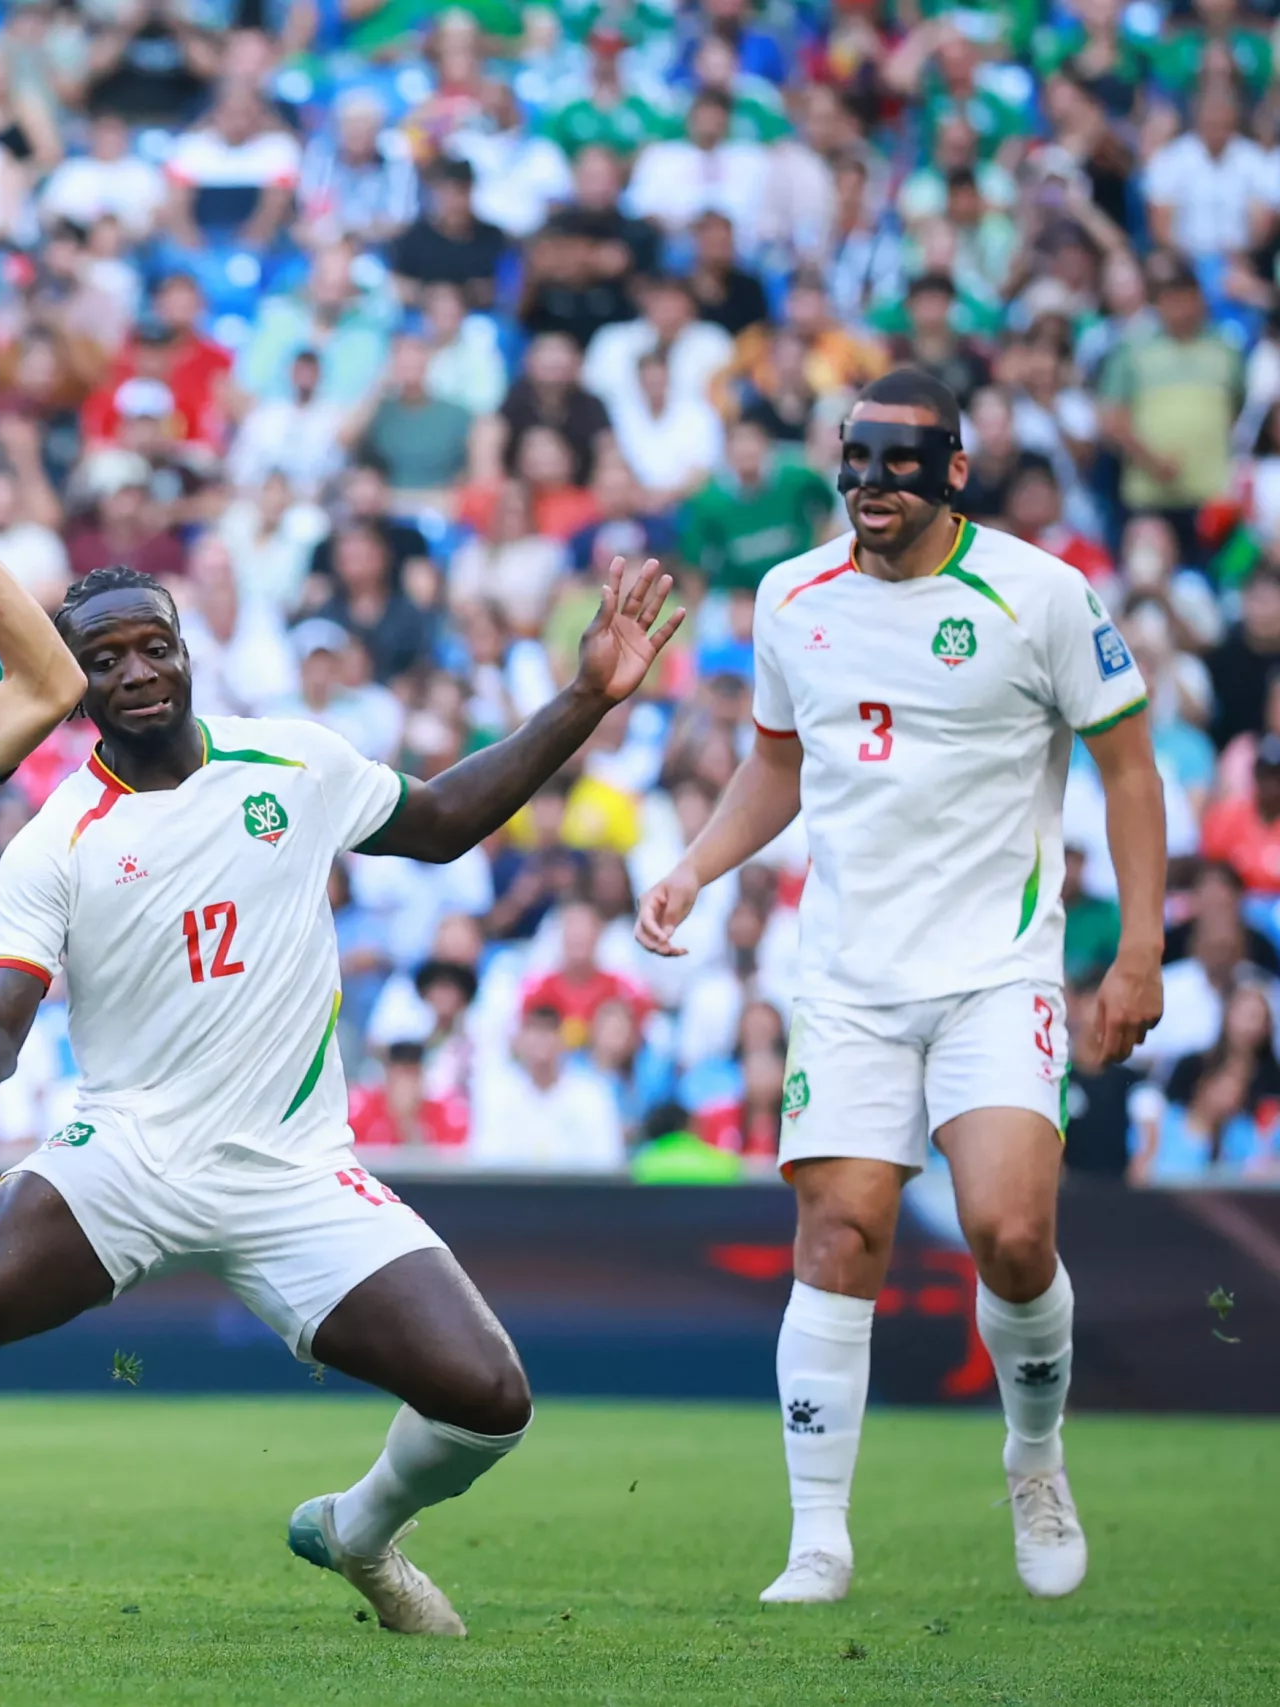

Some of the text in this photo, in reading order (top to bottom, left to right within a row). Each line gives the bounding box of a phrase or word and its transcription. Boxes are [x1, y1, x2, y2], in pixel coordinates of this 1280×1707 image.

[858, 702, 893, 762] 3
[115, 869, 150, 886] KELME
[182, 900, 246, 984] 12
